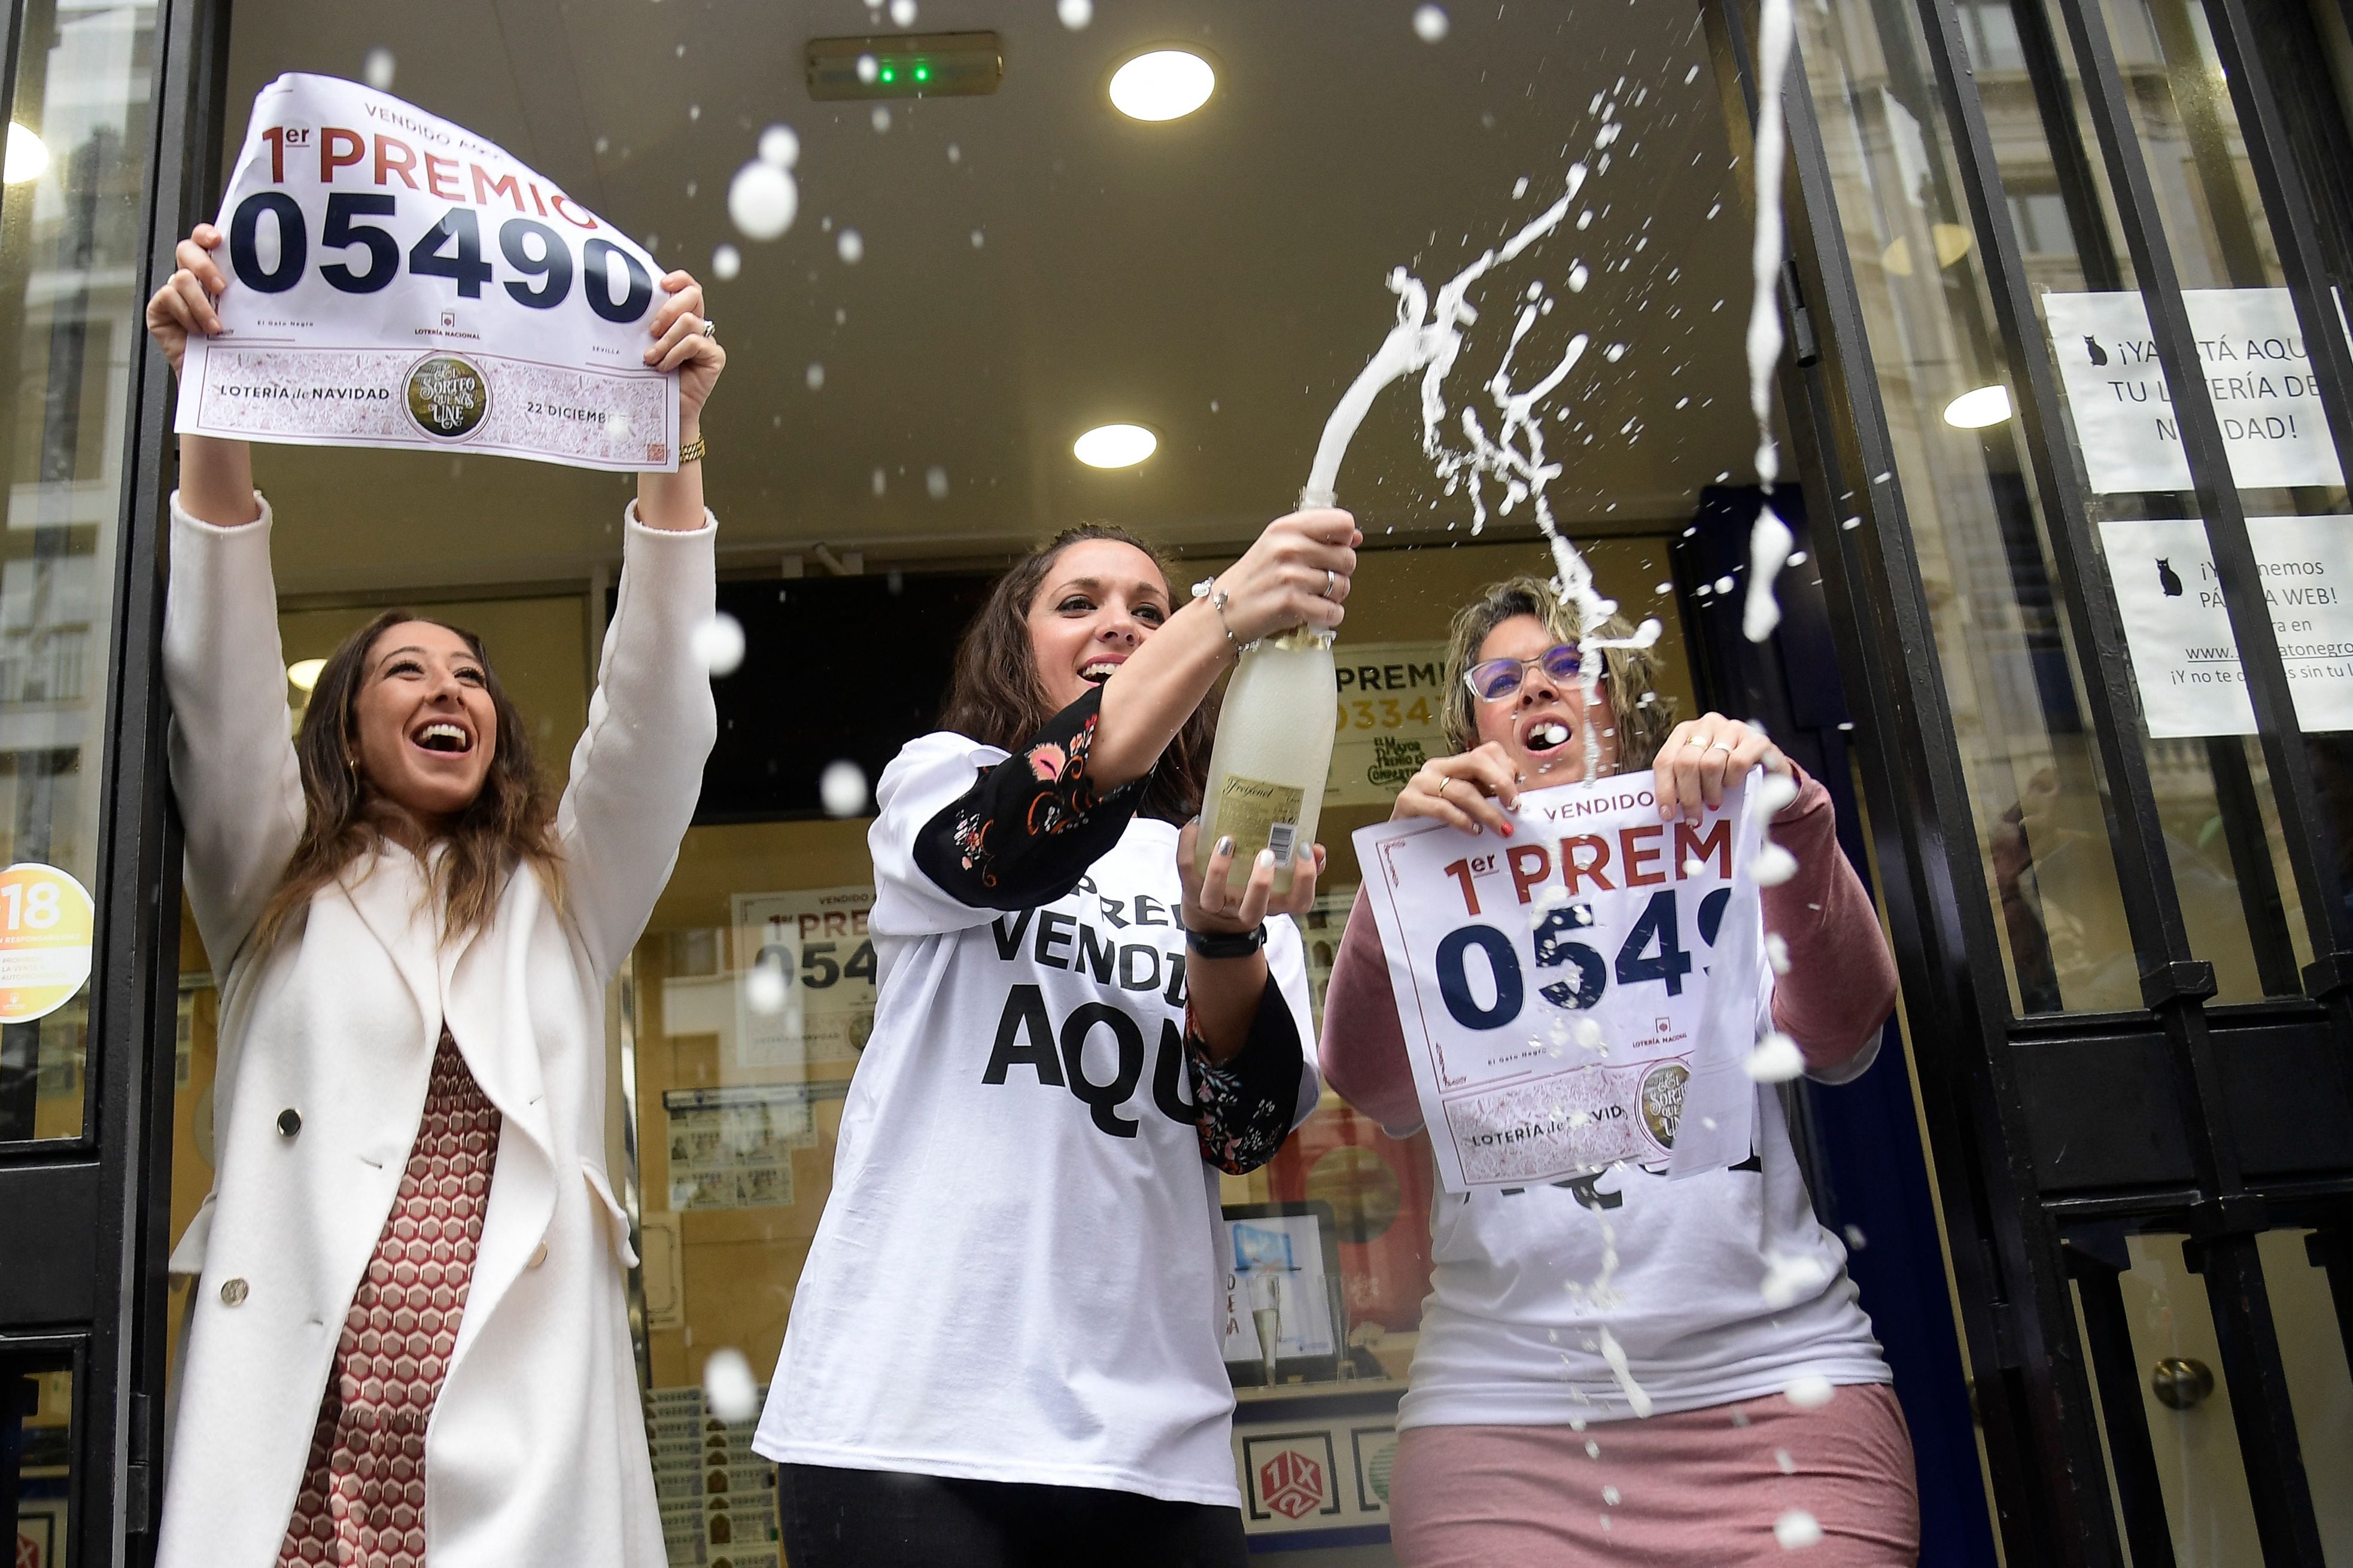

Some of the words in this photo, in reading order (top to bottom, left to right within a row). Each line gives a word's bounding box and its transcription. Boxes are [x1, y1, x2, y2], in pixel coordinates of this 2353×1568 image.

[364, 102, 450, 146] VENDIDO
[262, 126, 310, 184] 1er
[320, 127, 598, 230] PREMIO
[230, 191, 653, 324] 05490
[445, 331, 481, 340] NACIONAL
[592, 345, 620, 354] SEVILLA
[221, 384, 289, 399] LOTERÍA
[312, 388, 390, 400] NAVIDAD
[2107, 380, 2147, 403] TU
[527, 401, 542, 414] 22
[548, 405, 619, 424] DICIEMB
[2282, 587, 2338, 605] WEB!
[2292, 620, 2312, 632] en
[2191, 671, 2211, 684] no
[2215, 669, 2232, 683] te
[2300, 665, 2323, 679] sin
[2327, 665, 2344, 677] tu
[1543, 791, 1655, 823] VENDIDO
[1444, 853, 1496, 917] 1er
[1506, 820, 1732, 905] PREM
[1472, 1122, 1544, 1147] LOTERÍA
